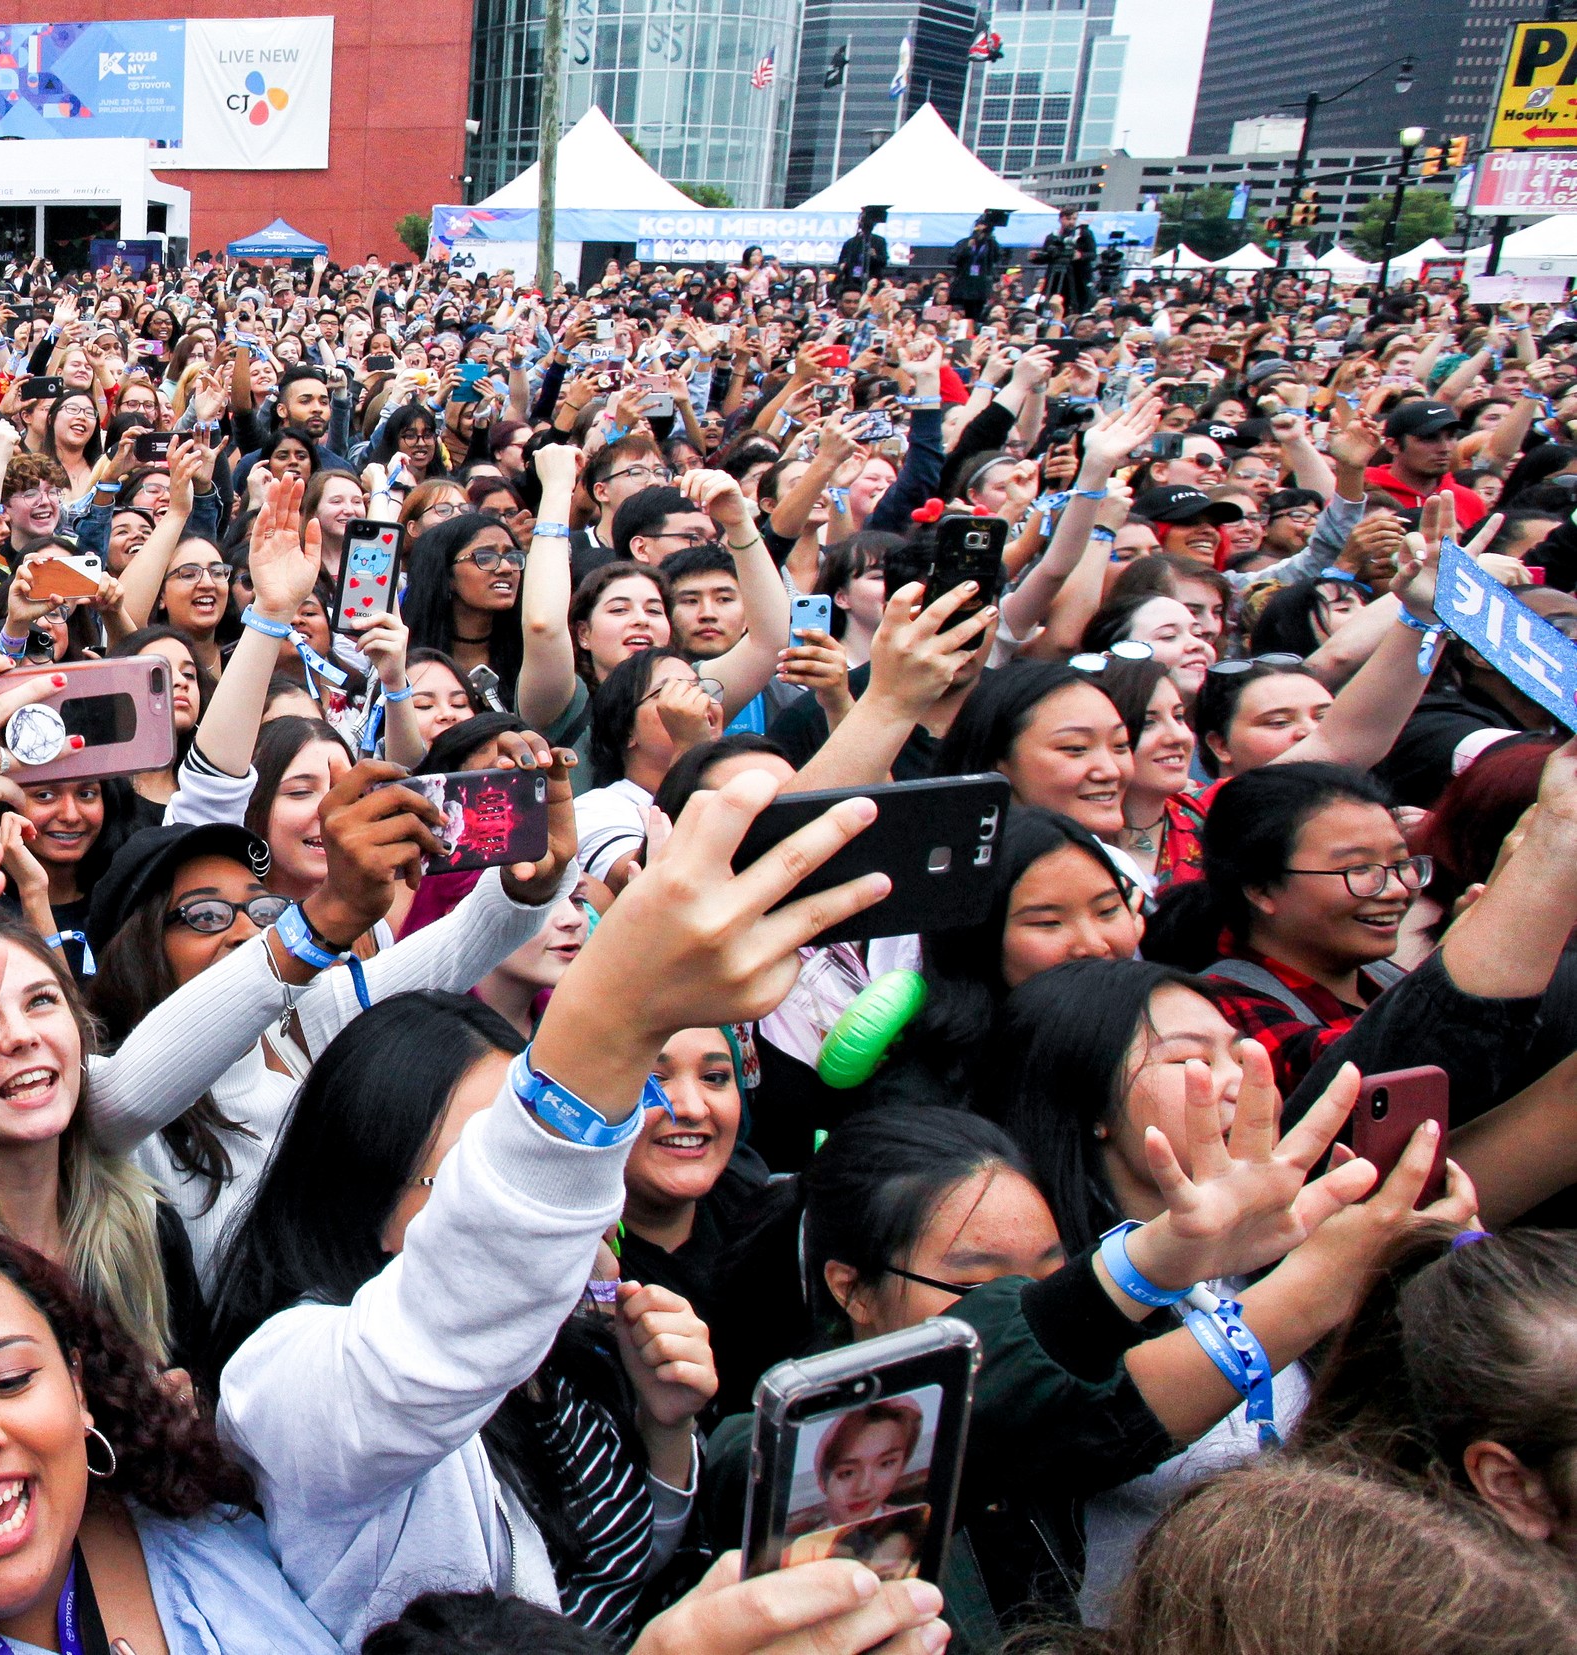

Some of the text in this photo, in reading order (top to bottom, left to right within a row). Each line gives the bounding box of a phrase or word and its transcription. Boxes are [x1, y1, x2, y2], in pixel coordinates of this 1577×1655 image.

[128, 51, 158, 63] 2018
[219, 49, 300, 63] LIVE NEW
[128, 64, 146, 74] NY
[140, 81, 171, 89] TOYOTA
[98, 105, 177, 113] PRUDENTIAL CENTER
[226, 94, 251, 114] CJ
[1504, 109, 1558, 123] Hourly
[1491, 157, 1529, 172] Don
[1530, 174, 1544, 188] &
[28, 186, 61, 195] Mamonde
[73, 185, 111, 196] innisfree
[638, 216, 715, 237] KCON
[558, 1106, 573, 1118] NY
[560, 1101, 582, 1119] 2018
[1126, 1282, 1162, 1303] LET'S
[1203, 1332, 1222, 1356] 2018
[1218, 1350, 1242, 1377] KCON
[65, 1590, 75, 1628] TOYOTA
